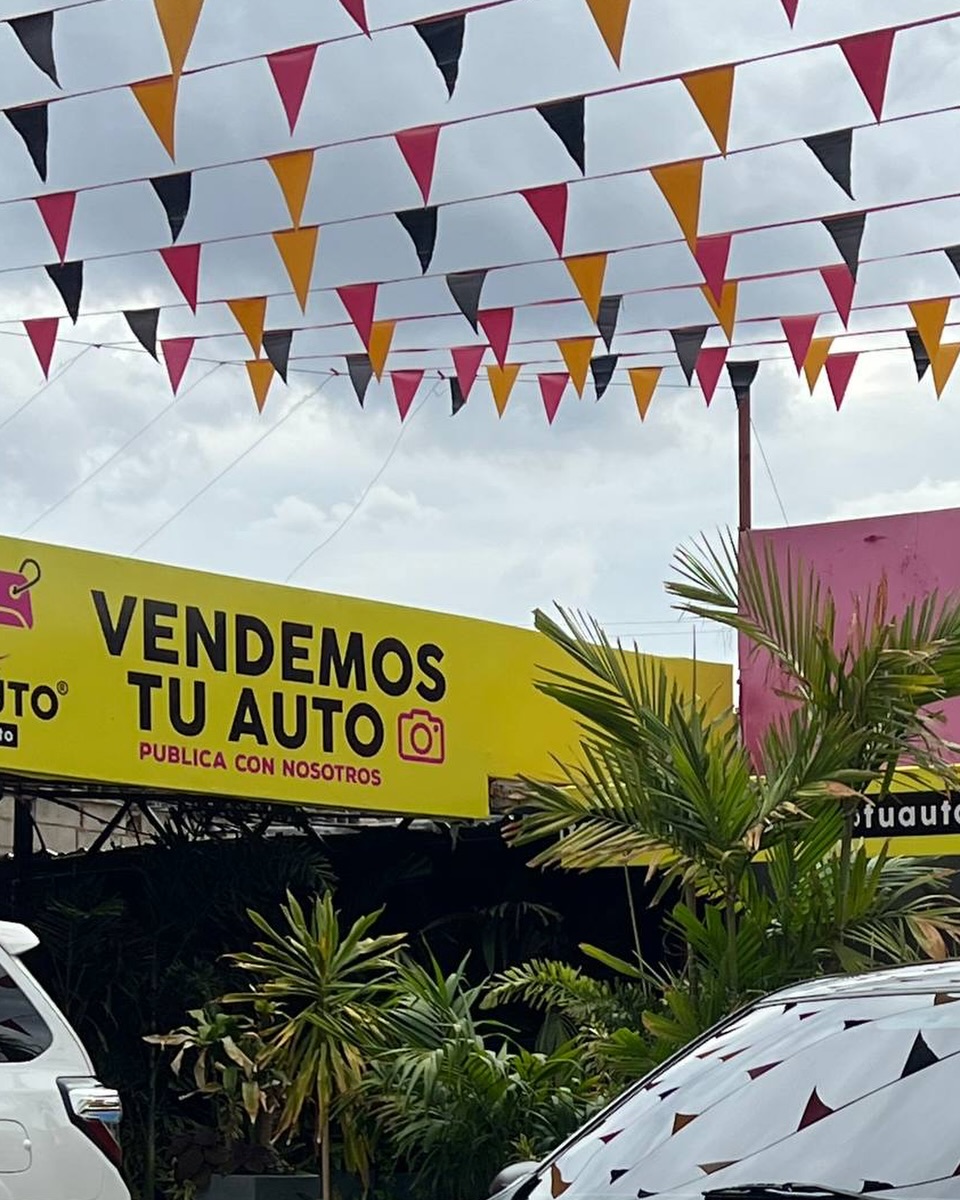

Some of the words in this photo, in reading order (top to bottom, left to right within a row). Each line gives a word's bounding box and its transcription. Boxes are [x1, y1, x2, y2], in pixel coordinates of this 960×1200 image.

[90, 589, 447, 702] VENDEMOS
[127, 671, 206, 737] TU
[228, 687, 385, 758] AUTO
[139, 741, 228, 770] PUBLICA
[234, 754, 275, 776] CON
[282, 761, 383, 787] NOSOTROS
